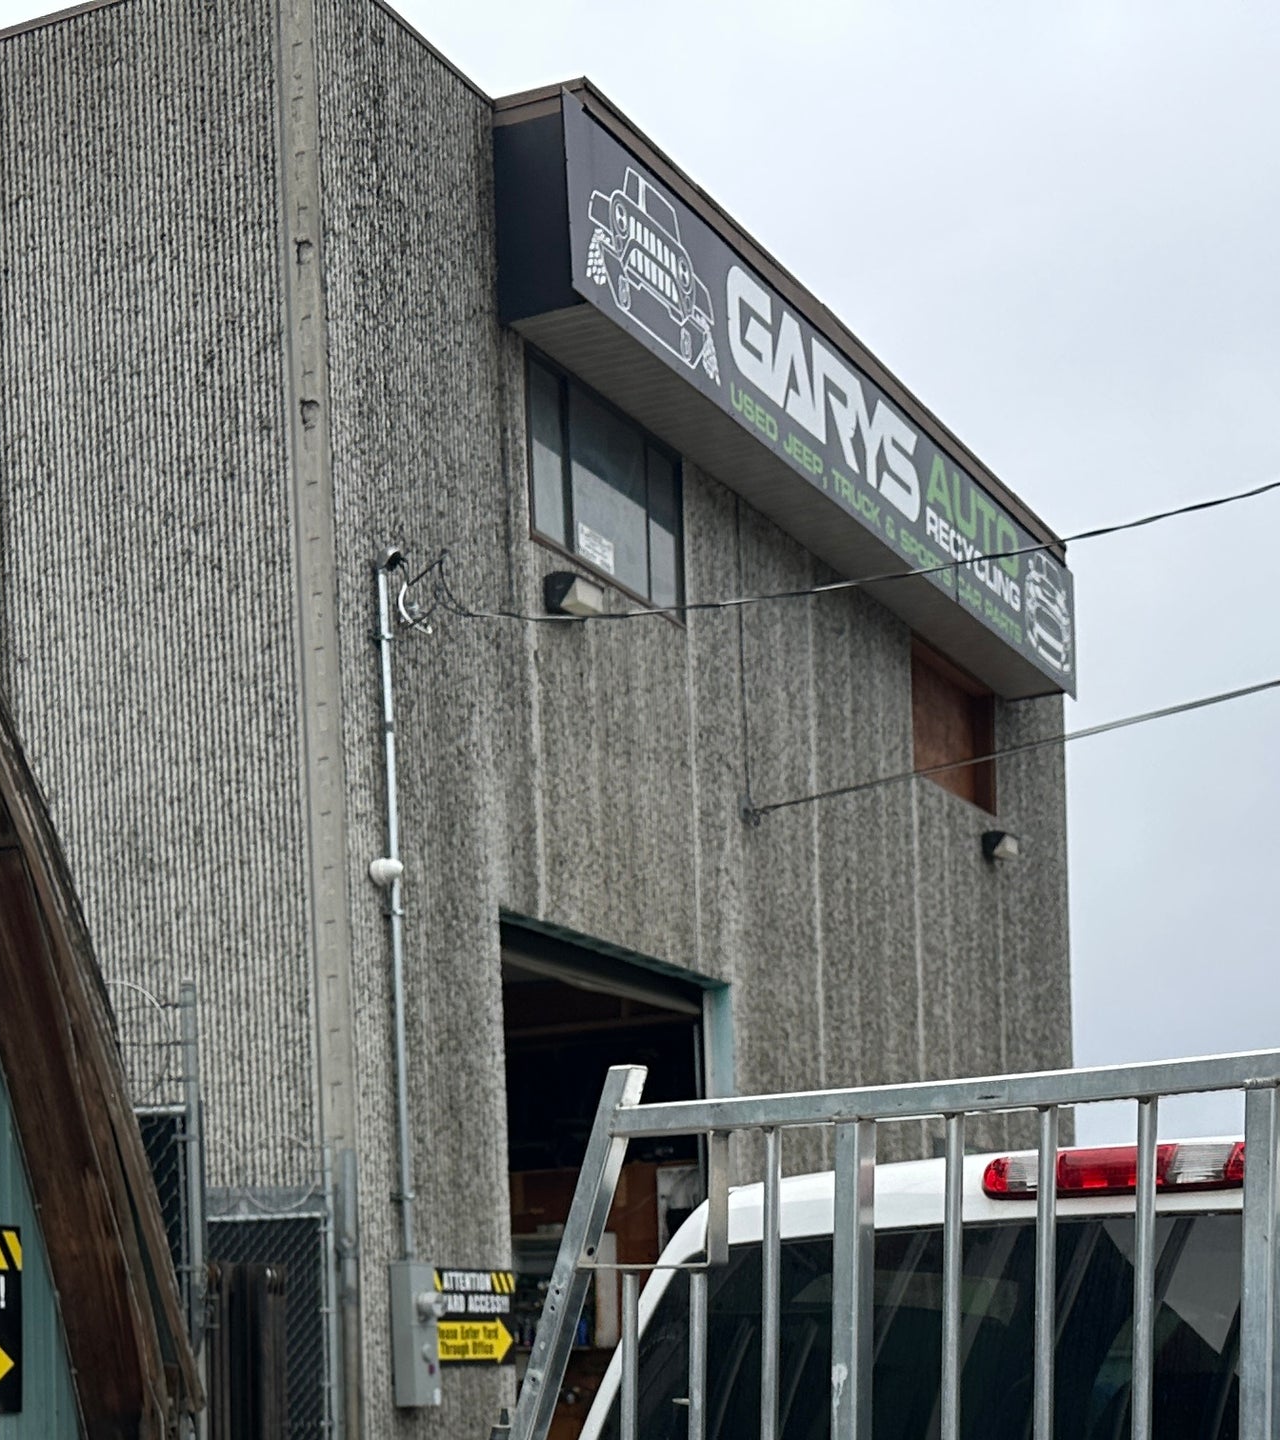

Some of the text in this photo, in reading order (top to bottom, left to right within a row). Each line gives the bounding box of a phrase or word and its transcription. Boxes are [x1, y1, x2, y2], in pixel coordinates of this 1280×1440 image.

[726, 264, 920, 523] GARYS
[729, 381, 779, 442] USED
[831, 467, 881, 528] TRUCK
[926, 452, 1019, 579] AUTO
[926, 506, 1020, 612] RECYCLING
[442, 1271, 492, 1291] ATTENTION
